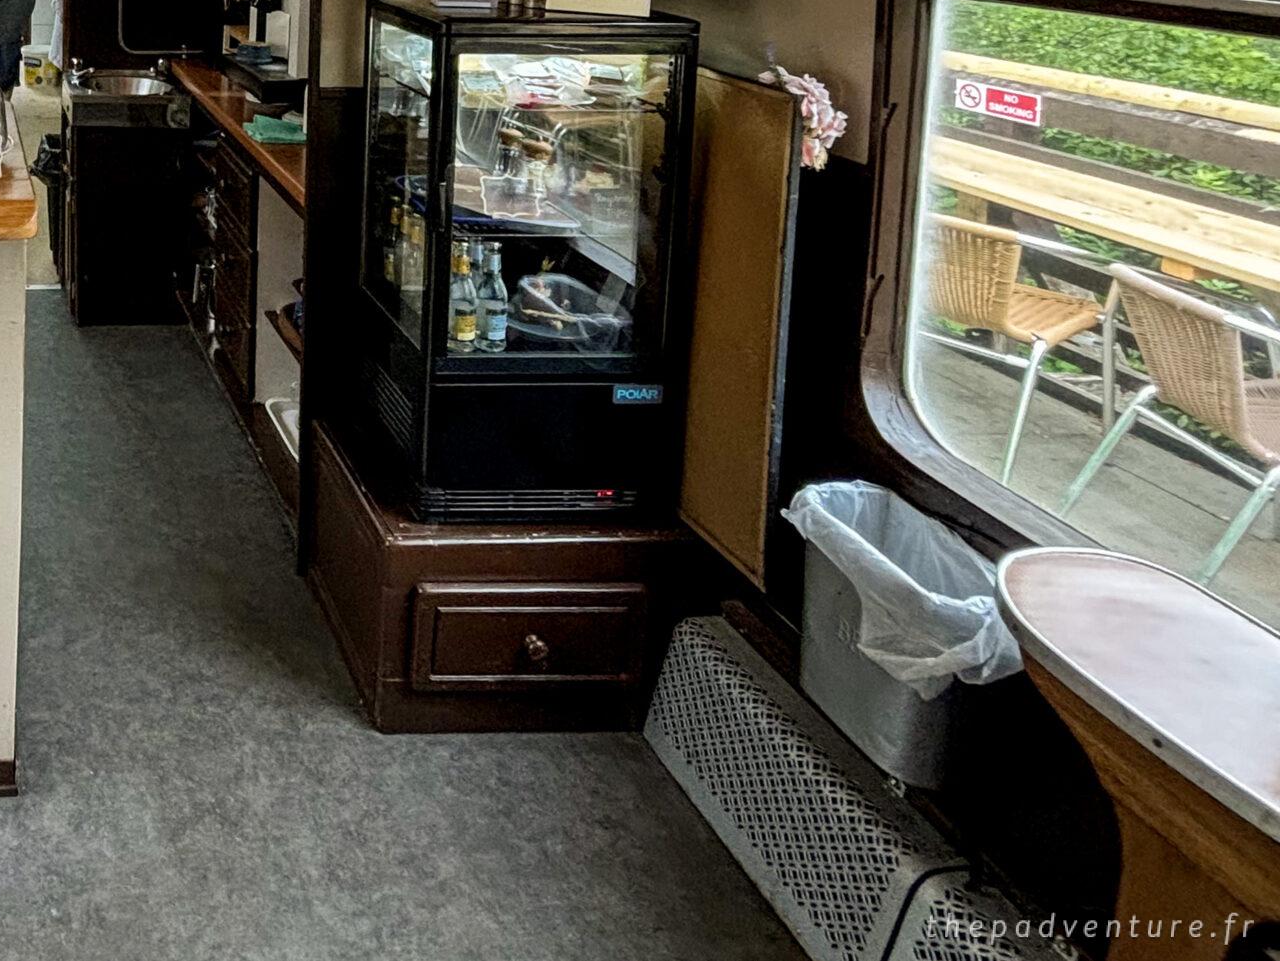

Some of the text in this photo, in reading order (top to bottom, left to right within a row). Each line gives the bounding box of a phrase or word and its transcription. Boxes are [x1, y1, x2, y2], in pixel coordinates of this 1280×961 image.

[1004, 94, 1019, 104] NO
[988, 102, 1034, 119] SMOKING
[617, 388, 658, 400] POLAR
